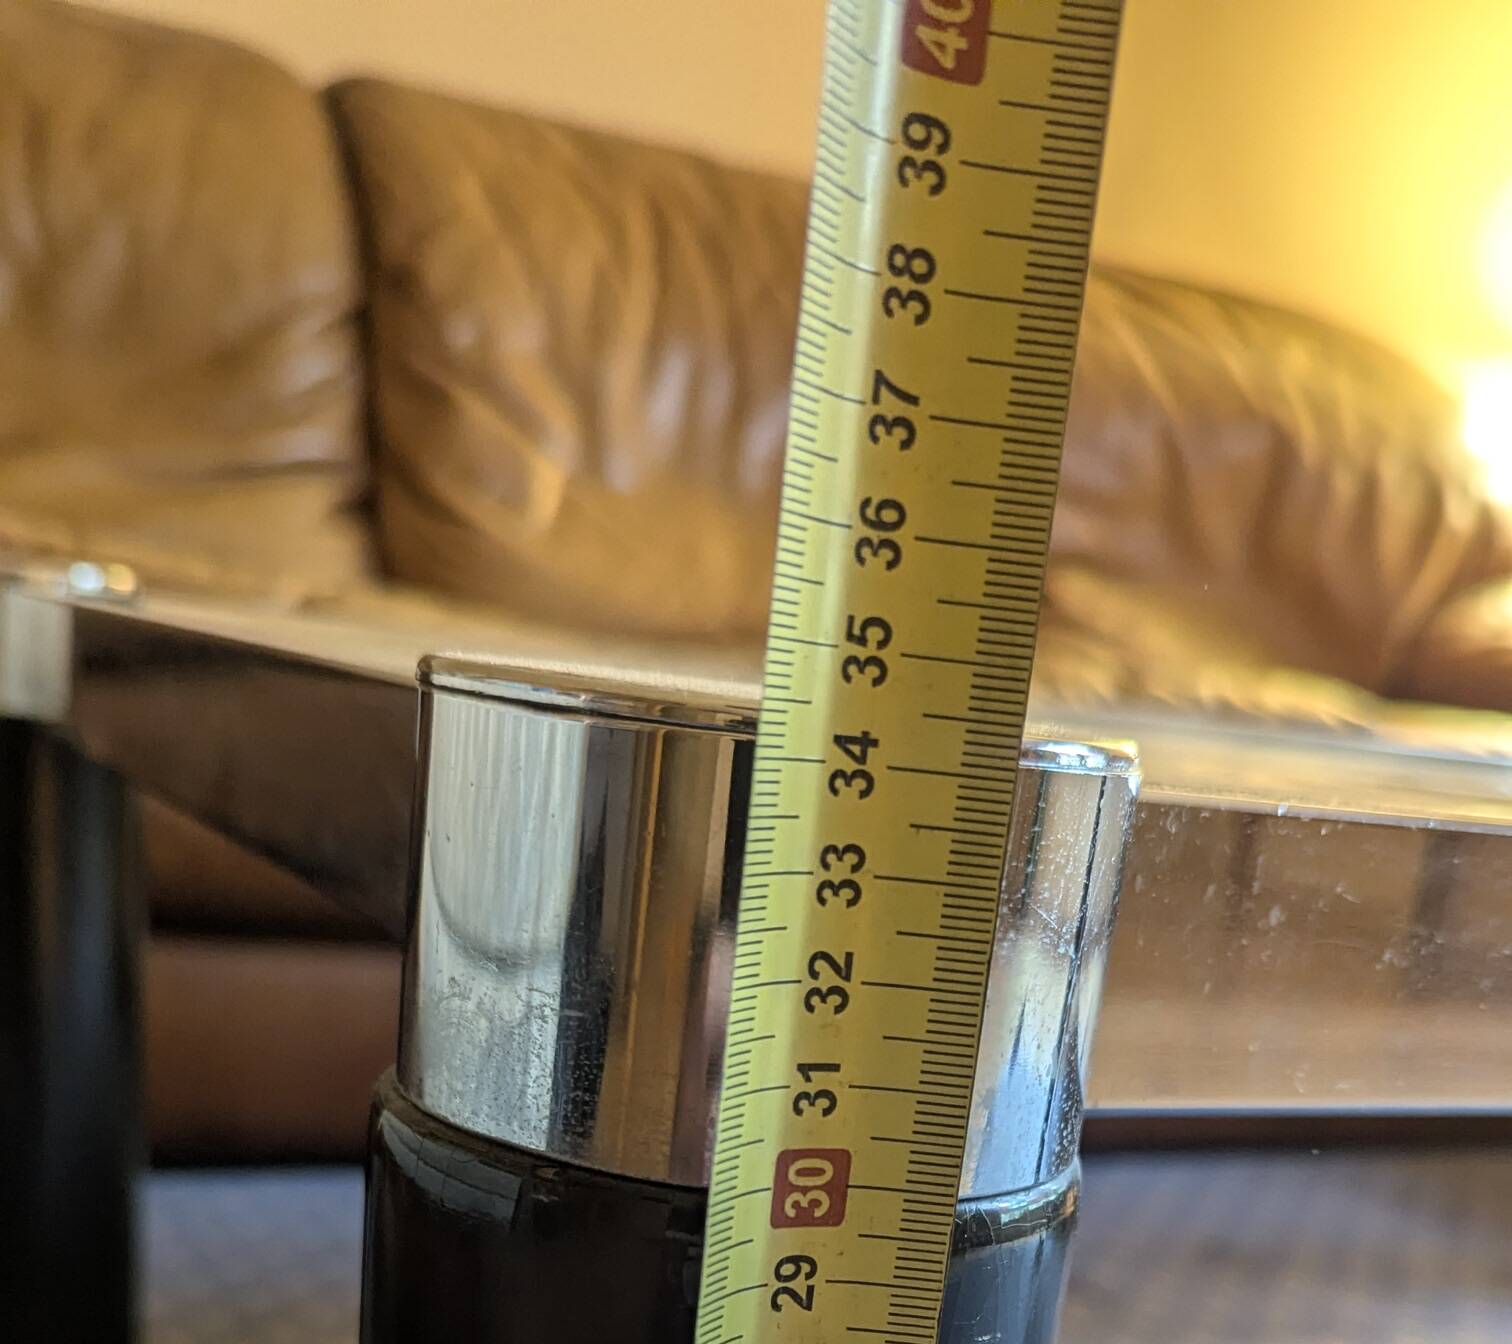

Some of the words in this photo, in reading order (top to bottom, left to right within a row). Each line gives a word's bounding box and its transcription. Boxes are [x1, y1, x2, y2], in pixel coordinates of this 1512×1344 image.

[898, 112, 951, 196] 39
[883, 244, 937, 326] 38
[868, 370, 920, 452] 37
[855, 497, 907, 571] 36
[842, 614, 894, 687] 35
[829, 730, 879, 800] 34
[816, 843, 867, 908] 33
[804, 950, 854, 1016] 32
[793, 1062, 841, 1117] 31
[784, 1156, 834, 1219] 30
[771, 1254, 820, 1313] 29
